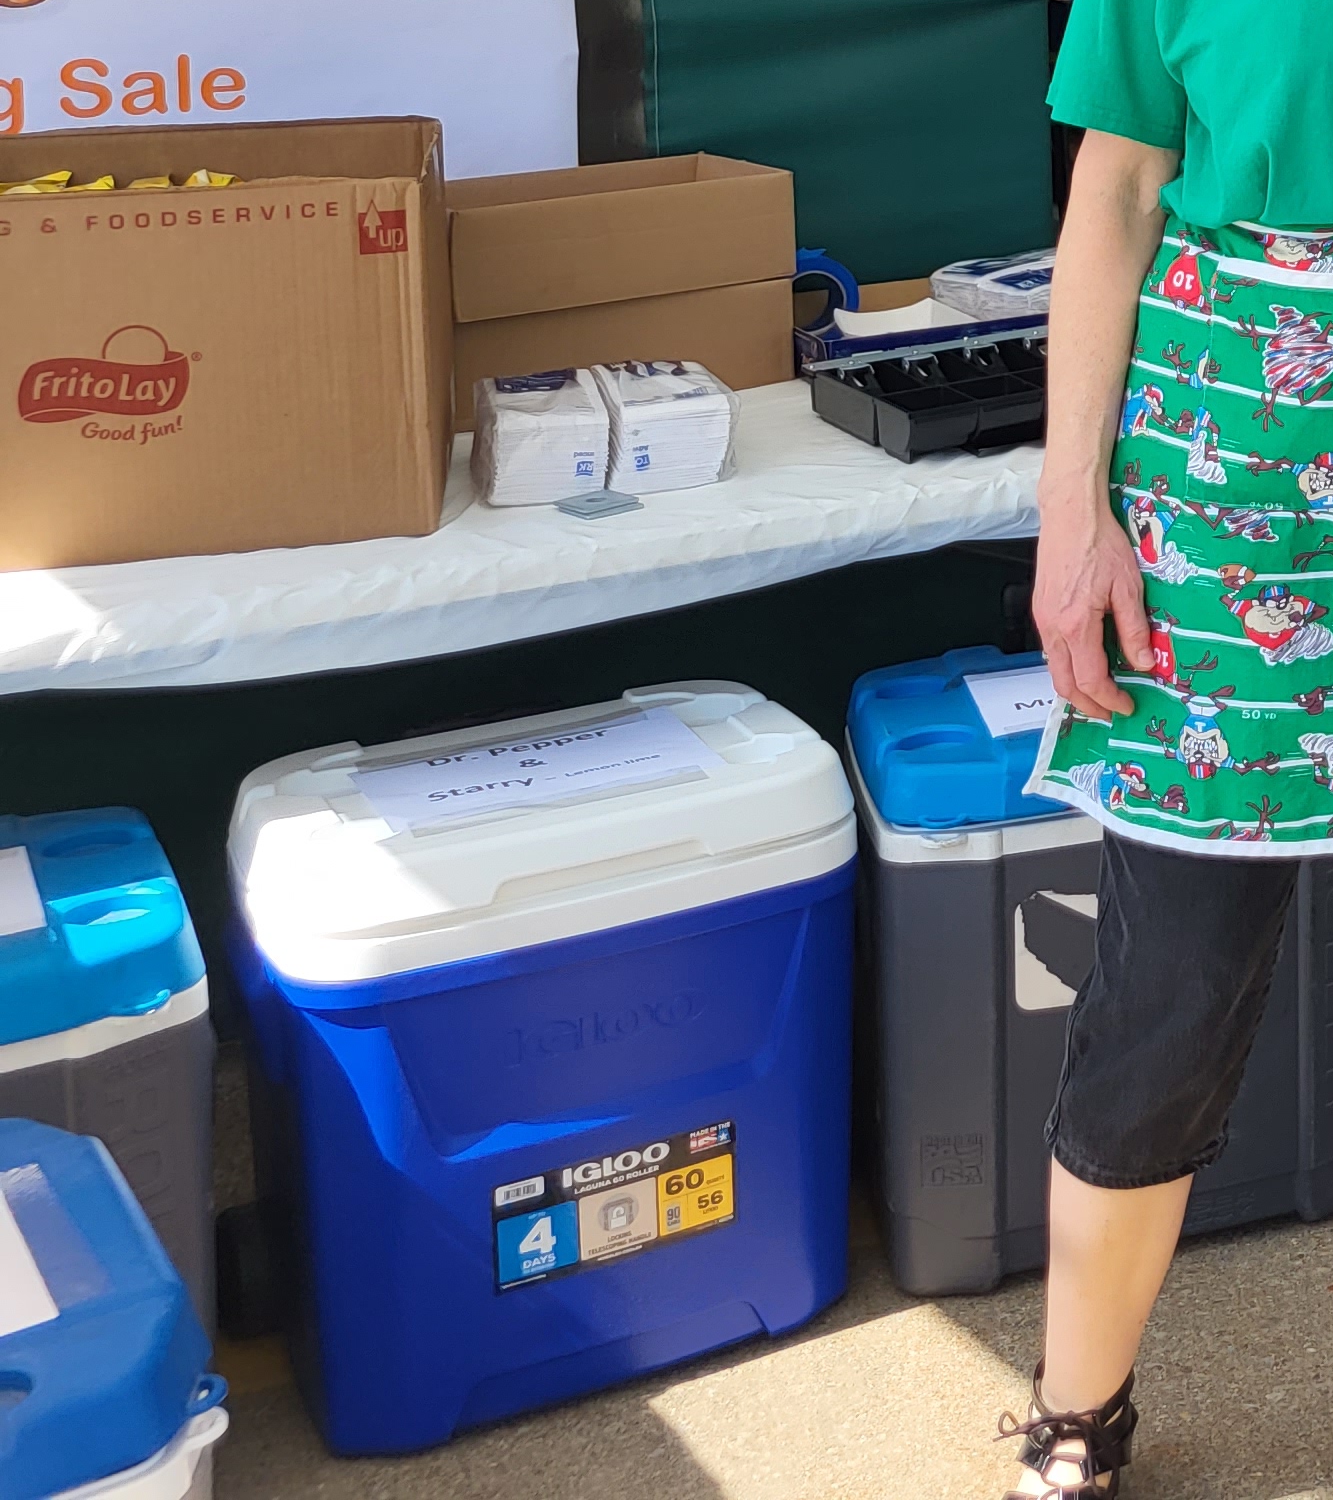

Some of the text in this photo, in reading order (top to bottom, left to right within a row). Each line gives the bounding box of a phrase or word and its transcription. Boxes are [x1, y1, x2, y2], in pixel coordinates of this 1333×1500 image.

[60, 54, 247, 118] Sale
[40, 218, 56, 233] &
[86, 201, 340, 231] FOODSERVICE
[378, 227, 404, 251] up
[1172, 270, 1195, 291] 10
[81, 415, 183, 445] Good fun!
[1241, 709, 1277, 721] 50 YD
[427, 729, 609, 767] Dr. Pepper
[519, 758, 548, 769] &
[428, 777, 534, 803] Starry
[563, 1143, 670, 1188] IGLOO
[575, 1165, 660, 1195] LAGUNA 60 ROLLER
[665, 1168, 705, 1196] 60
[697, 1189, 724, 1210] 56
[667, 1206, 681, 1221] 90
[519, 1216, 557, 1255] 4
[523, 1253, 556, 1269] DAYS
